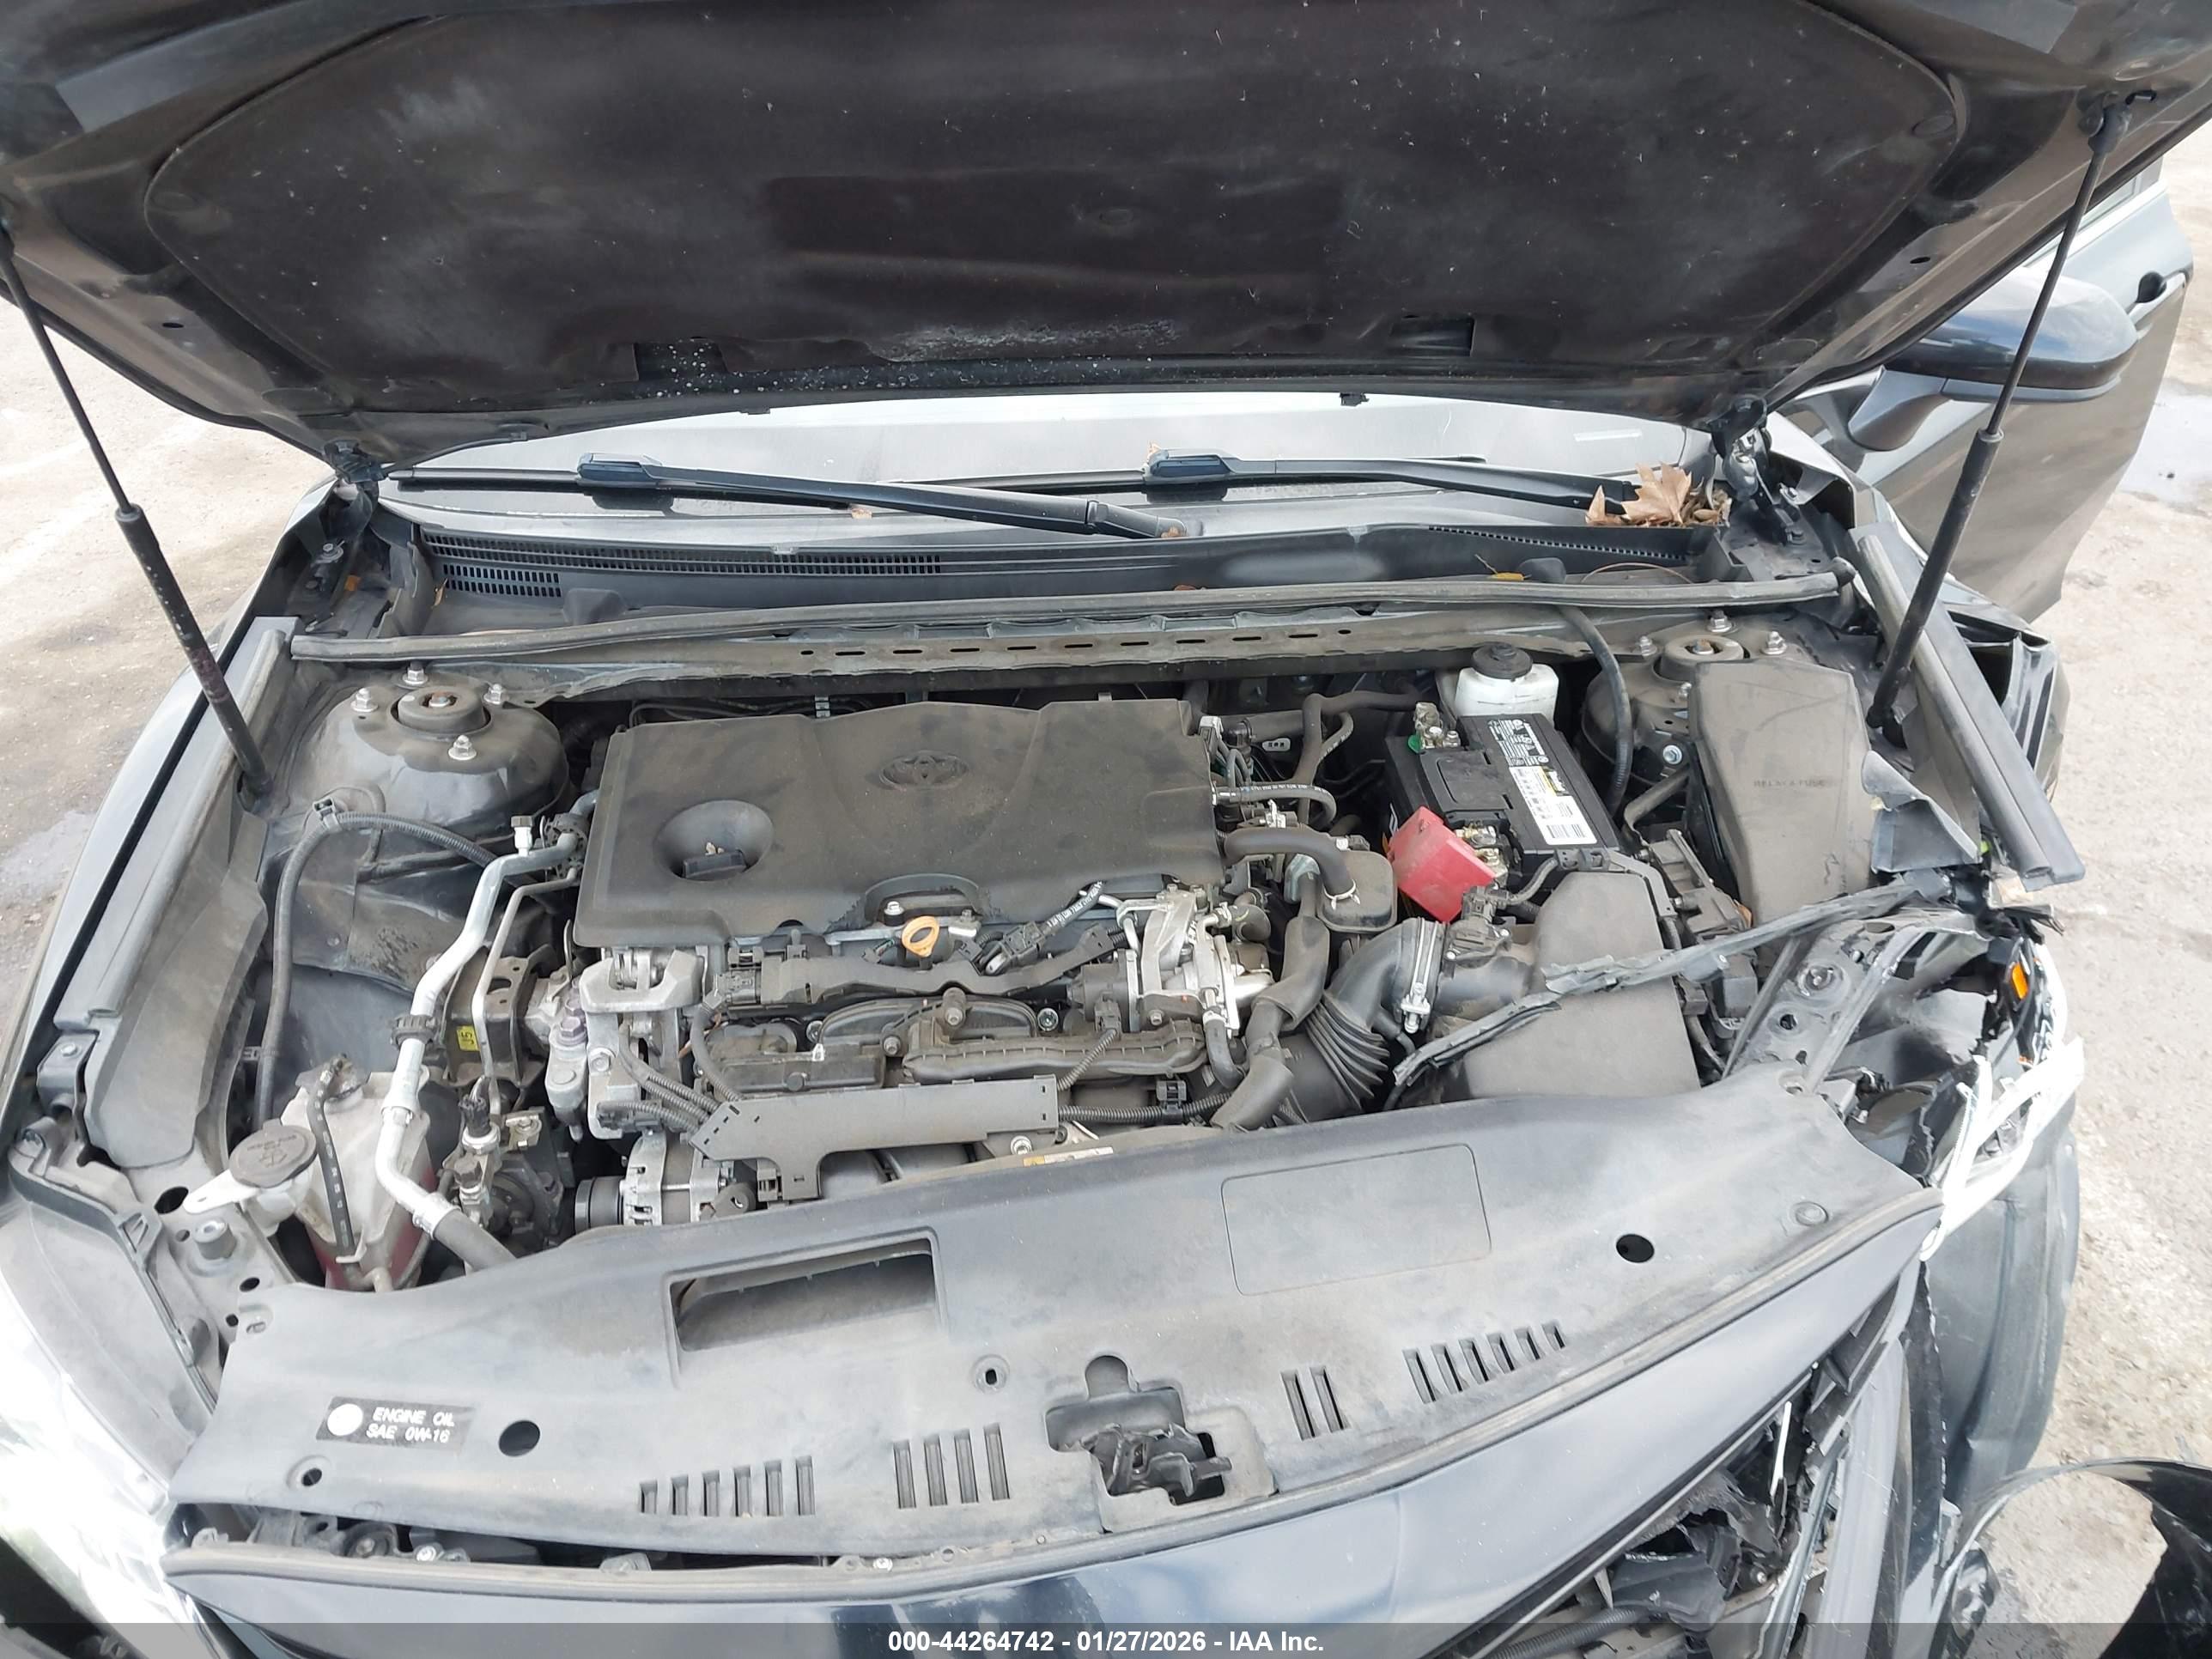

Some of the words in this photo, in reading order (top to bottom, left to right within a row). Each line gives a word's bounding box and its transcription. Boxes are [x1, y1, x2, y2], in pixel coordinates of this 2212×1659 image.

[372, 1407, 427, 1424] ENGINE
[433, 1411, 455, 1427] OIL
[366, 1423, 398, 1439] SAE
[404, 1426, 451, 1443] 0W-16
